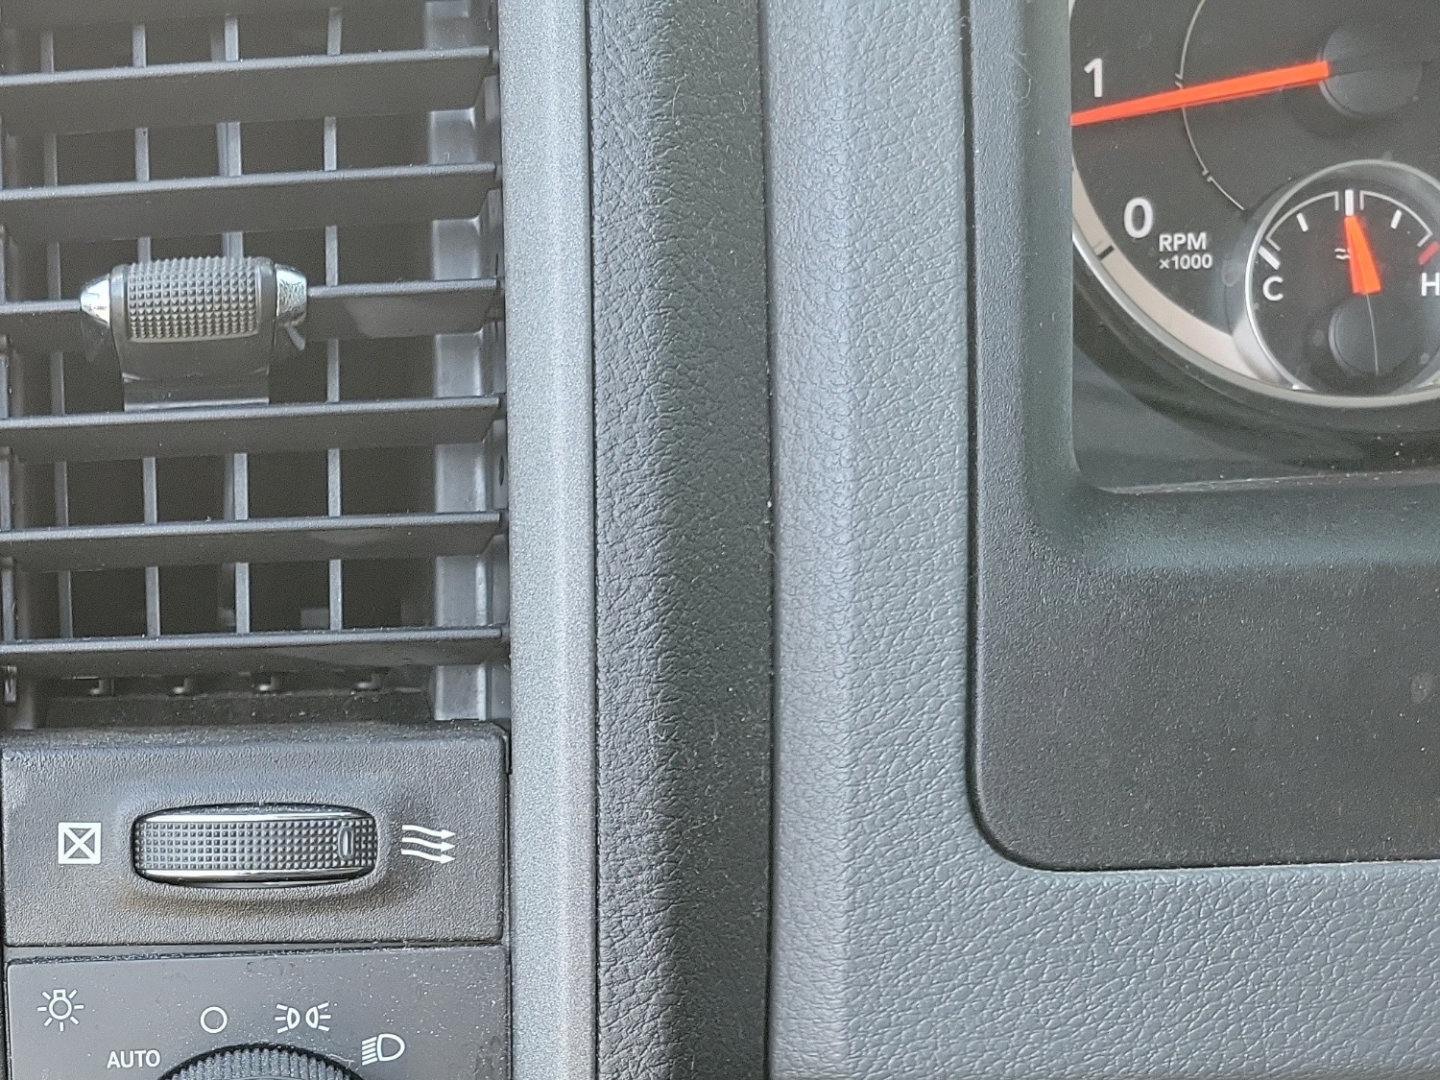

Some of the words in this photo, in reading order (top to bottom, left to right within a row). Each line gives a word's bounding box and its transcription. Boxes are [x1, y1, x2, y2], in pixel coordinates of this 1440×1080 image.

[1084, 58, 1103, 98] 1
[1123, 197, 1154, 238] 0
[1159, 232, 1207, 251] RPM
[1262, 276, 1284, 301] C
[1421, 272, 1440, 296] H
[106, 1050, 161, 1069] AUTO
